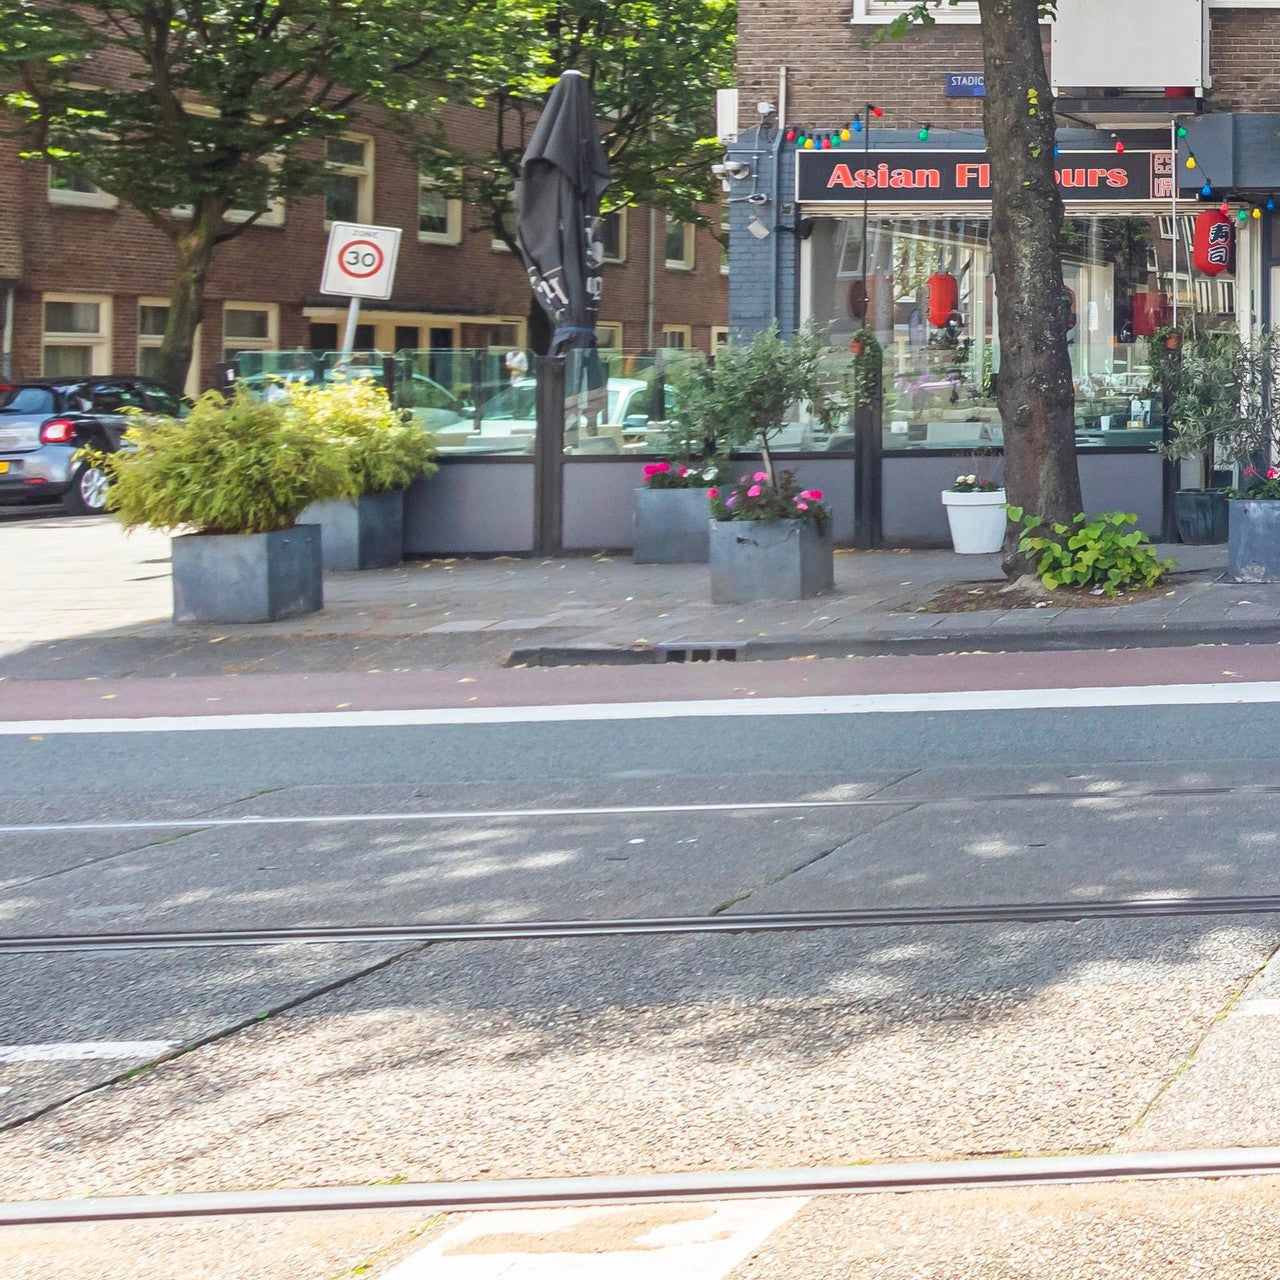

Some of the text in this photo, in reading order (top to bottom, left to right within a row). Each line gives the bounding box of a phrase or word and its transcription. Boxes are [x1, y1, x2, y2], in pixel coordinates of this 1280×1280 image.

[826, 163, 1129, 188] Asian Flurs
[351, 229, 379, 239] ZONE
[346, 250, 376, 267] 30
